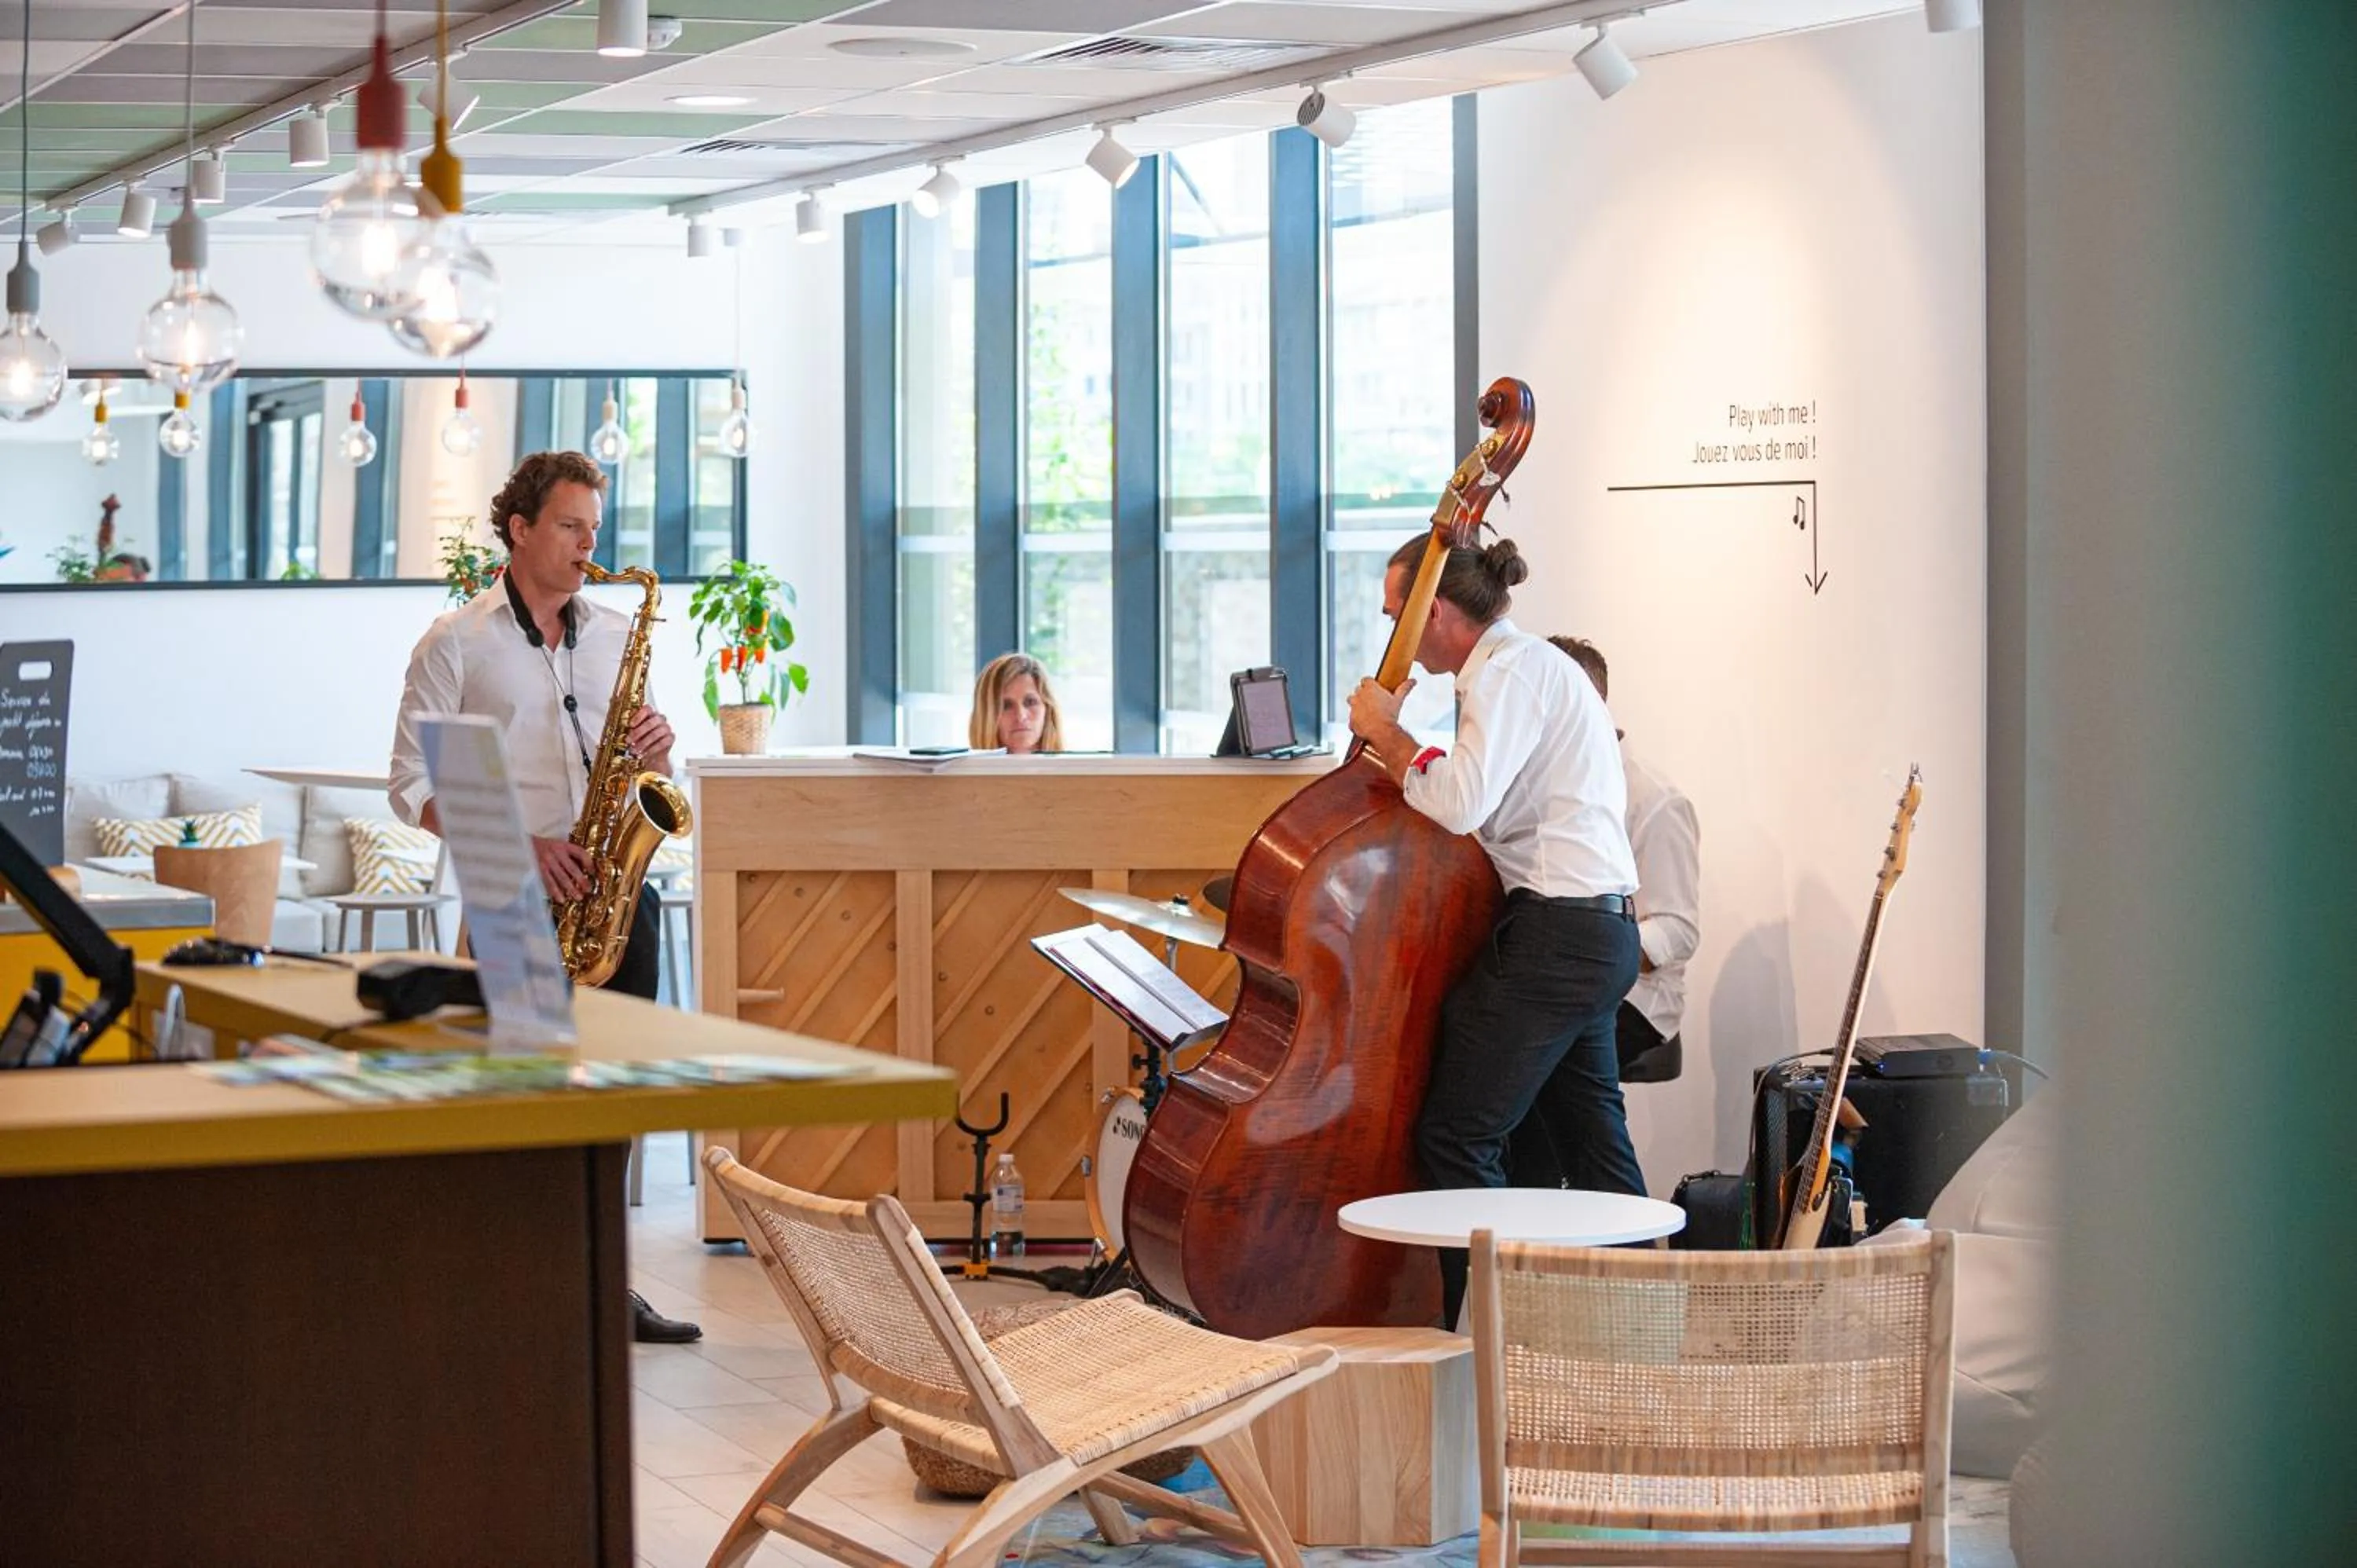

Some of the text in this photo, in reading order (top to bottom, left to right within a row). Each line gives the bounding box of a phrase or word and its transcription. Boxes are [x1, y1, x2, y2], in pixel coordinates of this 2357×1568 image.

[1729, 404, 1755, 433] Play
[1758, 401, 1784, 426] with
[1788, 405, 1809, 425] me
[1691, 441, 1728, 463] Jouez
[1732, 443, 1762, 462] vous
[1765, 438, 1781, 461] de
[1785, 435, 1809, 460] moi
